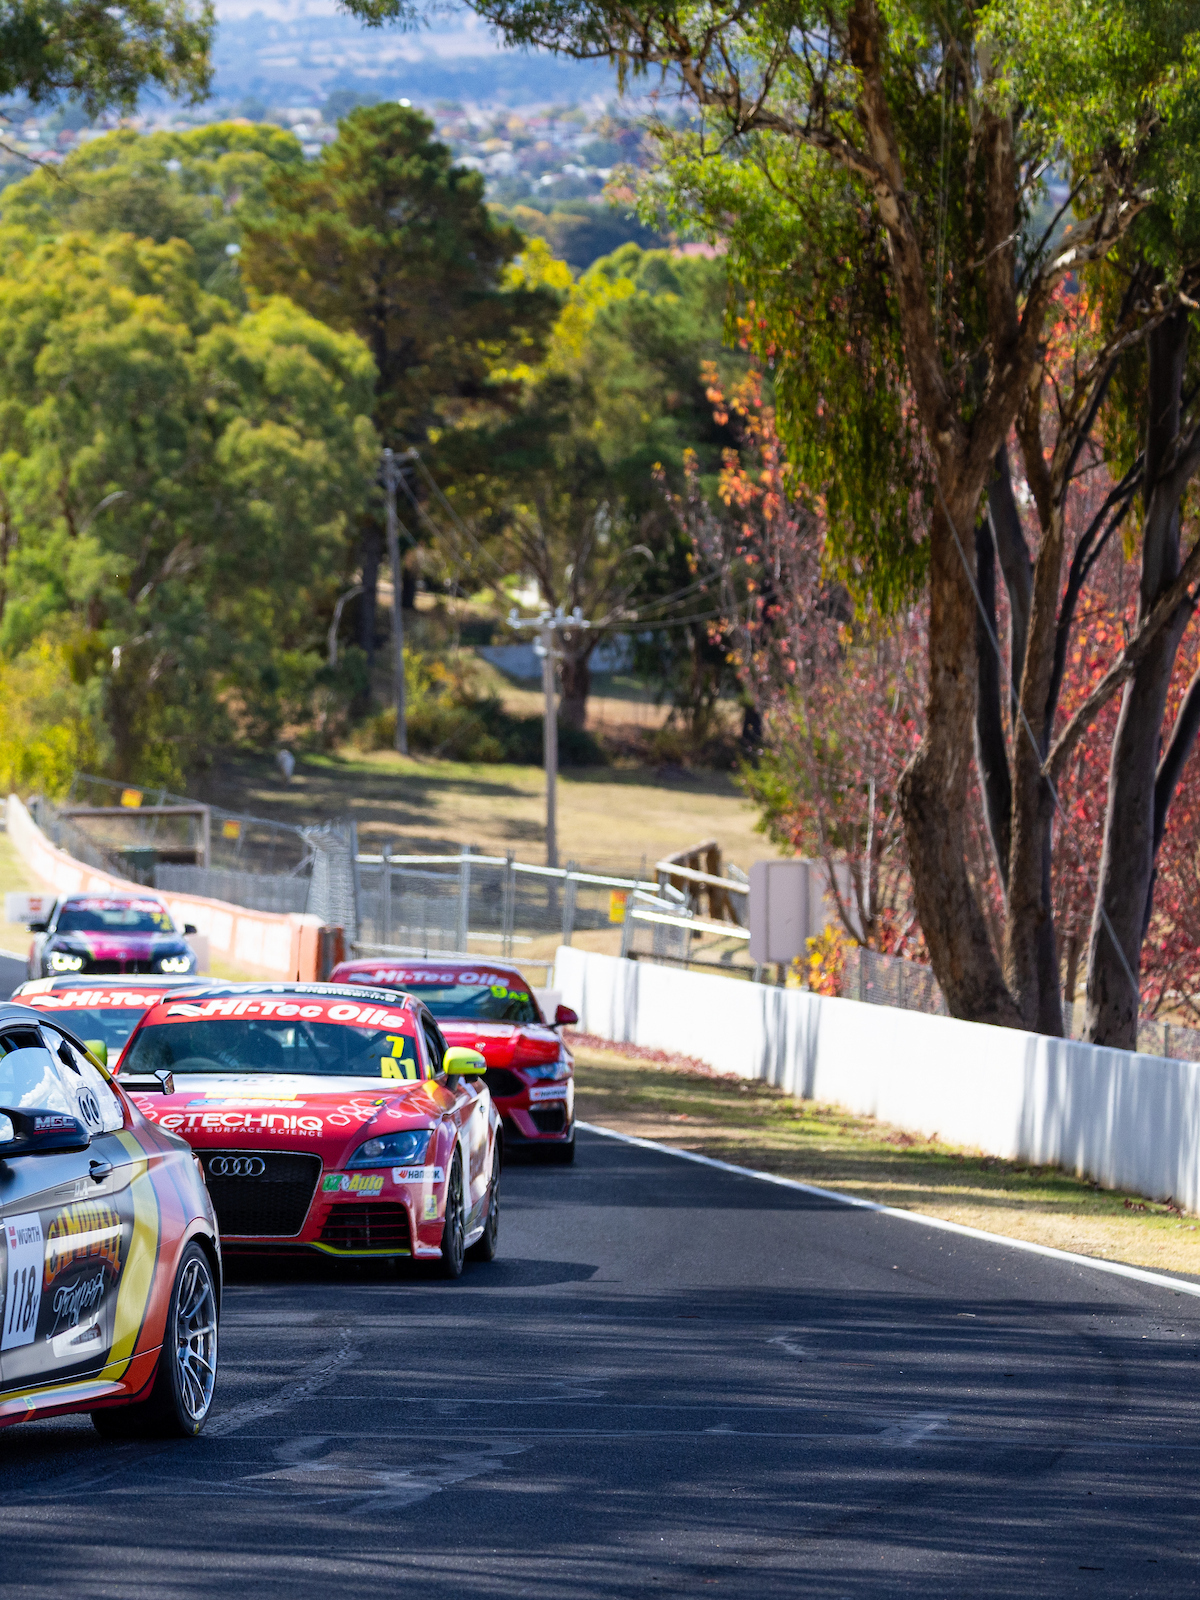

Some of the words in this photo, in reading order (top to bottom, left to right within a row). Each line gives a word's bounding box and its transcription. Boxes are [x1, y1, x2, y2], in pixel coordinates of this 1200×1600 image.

[458, 971, 510, 987] Oils
[490, 985, 507, 998] 9
[327, 1004, 405, 1028] Oils
[386, 1035, 404, 1058] 7
[381, 1056, 417, 1079] A1
[35, 1116, 77, 1130] MGC
[159, 1112, 324, 1131] GTECHNIQ
[270, 1128, 323, 1138] SCIENCE
